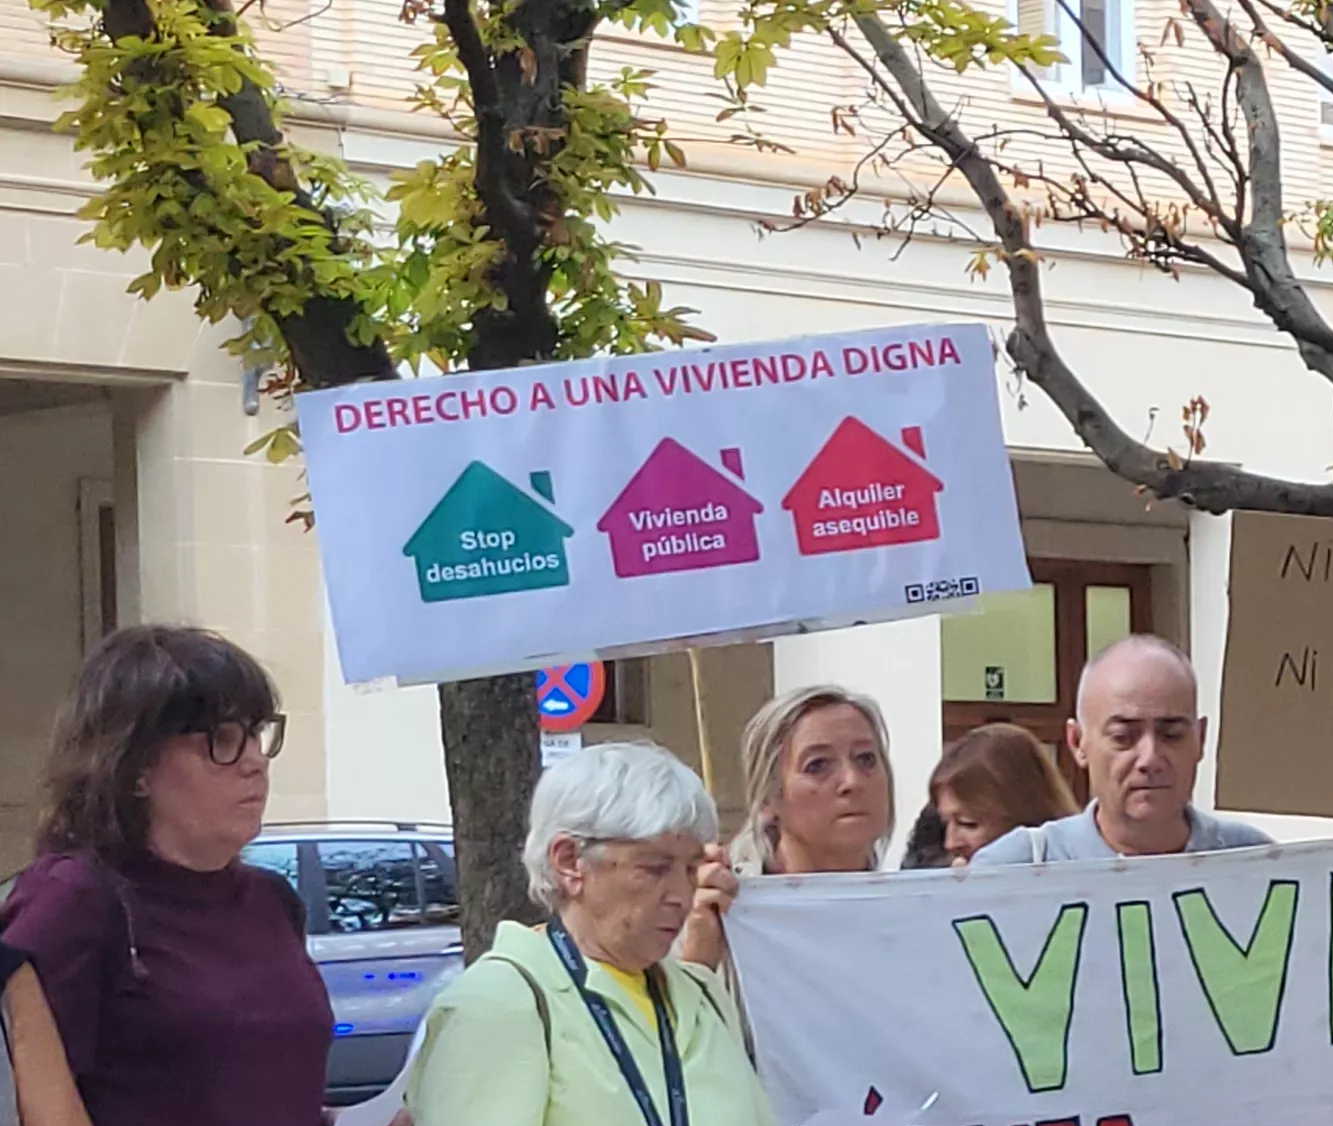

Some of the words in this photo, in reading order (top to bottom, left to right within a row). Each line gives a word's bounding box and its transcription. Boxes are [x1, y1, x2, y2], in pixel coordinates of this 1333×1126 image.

[334, 385, 517, 432] DERECHO
[530, 382, 554, 411] A
[564, 370, 645, 407] UNA
[654, 349, 834, 396] VIVIENDA
[842, 337, 961, 375] DIGNA
[819, 483, 905, 511] Alquiler
[628, 502, 728, 530] Vivienda
[812, 508, 919, 537] asequible
[460, 529, 516, 551] Stop
[642, 529, 726, 562] pública
[426, 552, 560, 583] desahucios
